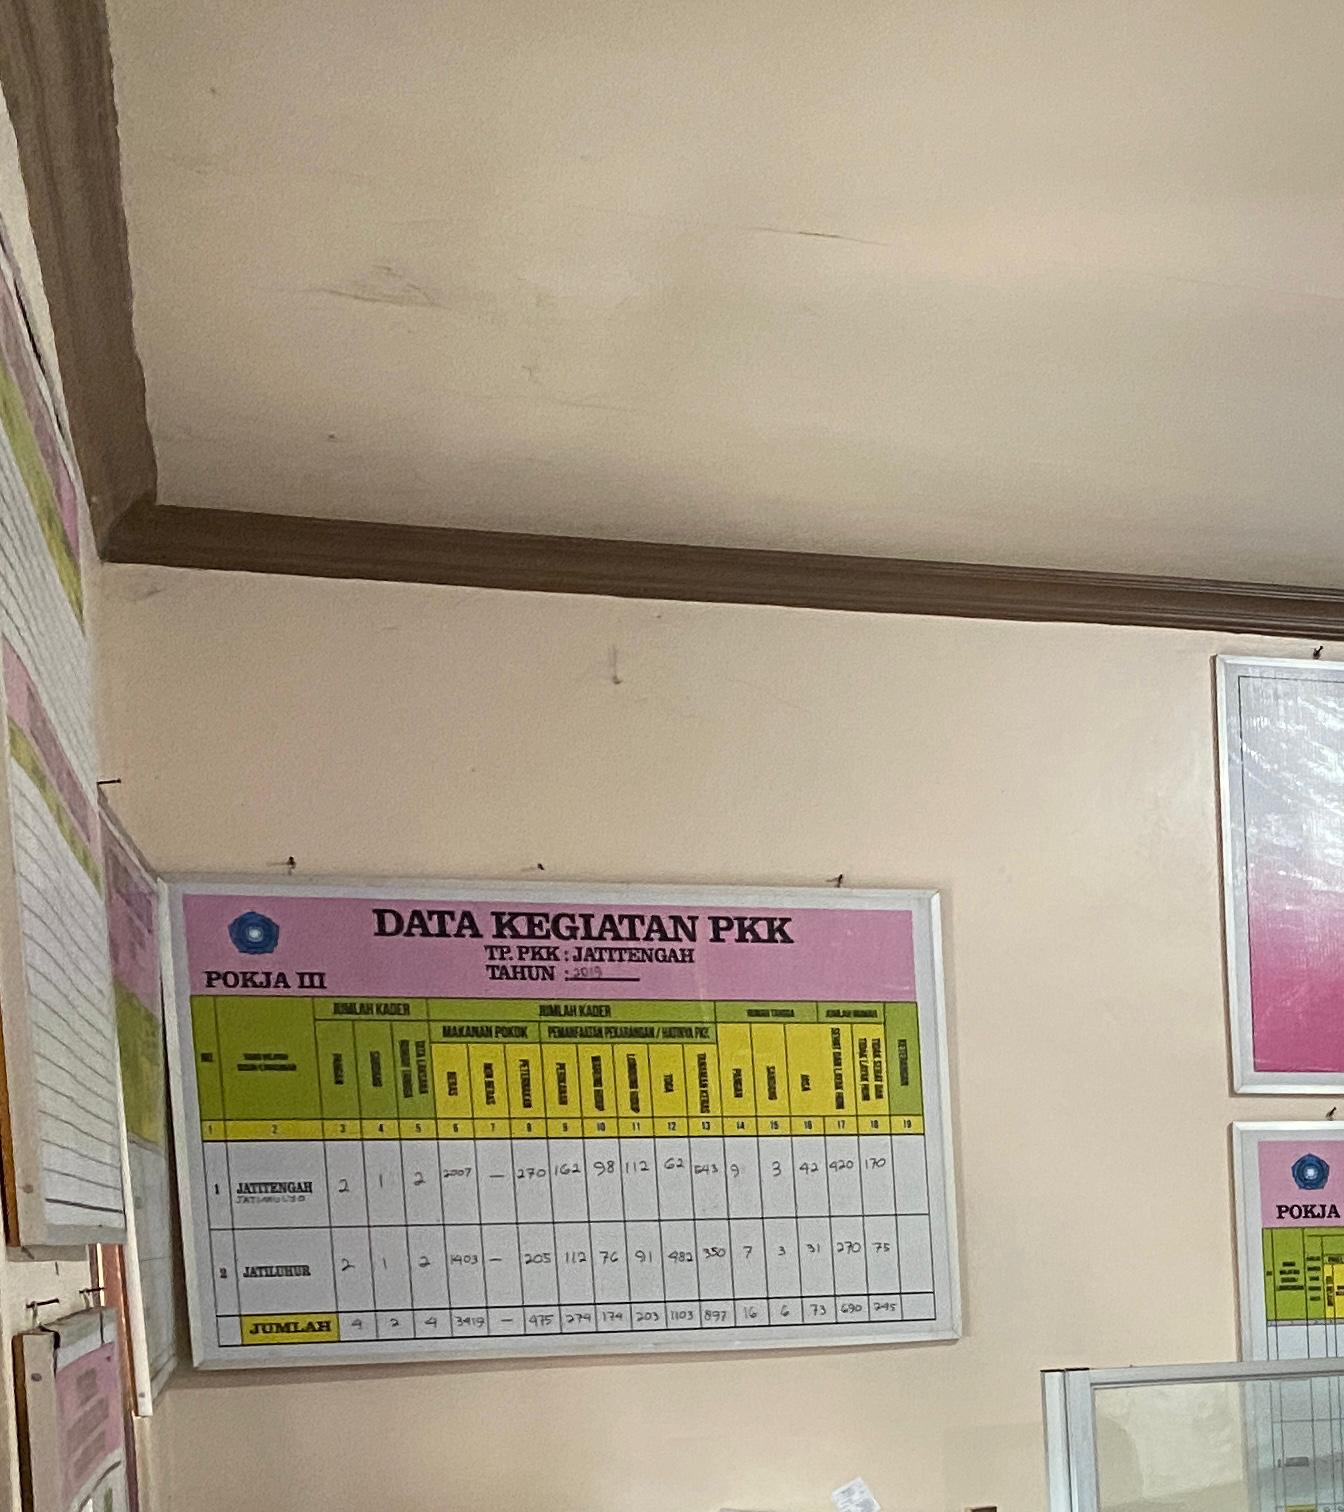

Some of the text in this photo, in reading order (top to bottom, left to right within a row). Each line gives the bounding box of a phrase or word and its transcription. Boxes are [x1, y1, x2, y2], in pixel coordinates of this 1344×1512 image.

[372, 908, 795, 944] DATA KEGIATAN PKK
[484, 944, 695, 964] TP. PKK JATITENGAH
[204, 970, 327, 990] POKJA III
[485, 964, 555, 981] TAHUN
[338, 1178, 350, 1193] 2
[592, 1161, 616, 1177] 98
[624, 1161, 650, 1174] 112
[772, 1161, 782, 1177] 3
[236, 1180, 314, 1195] JATITENGAH
[1276, 1203, 1342, 1220] POKJA
[524, 1252, 552, 1264] 205
[601, 1251, 619, 1264] 76
[242, 1264, 311, 1278] JATILUHUR
[249, 1321, 332, 1335] JUMLAH
